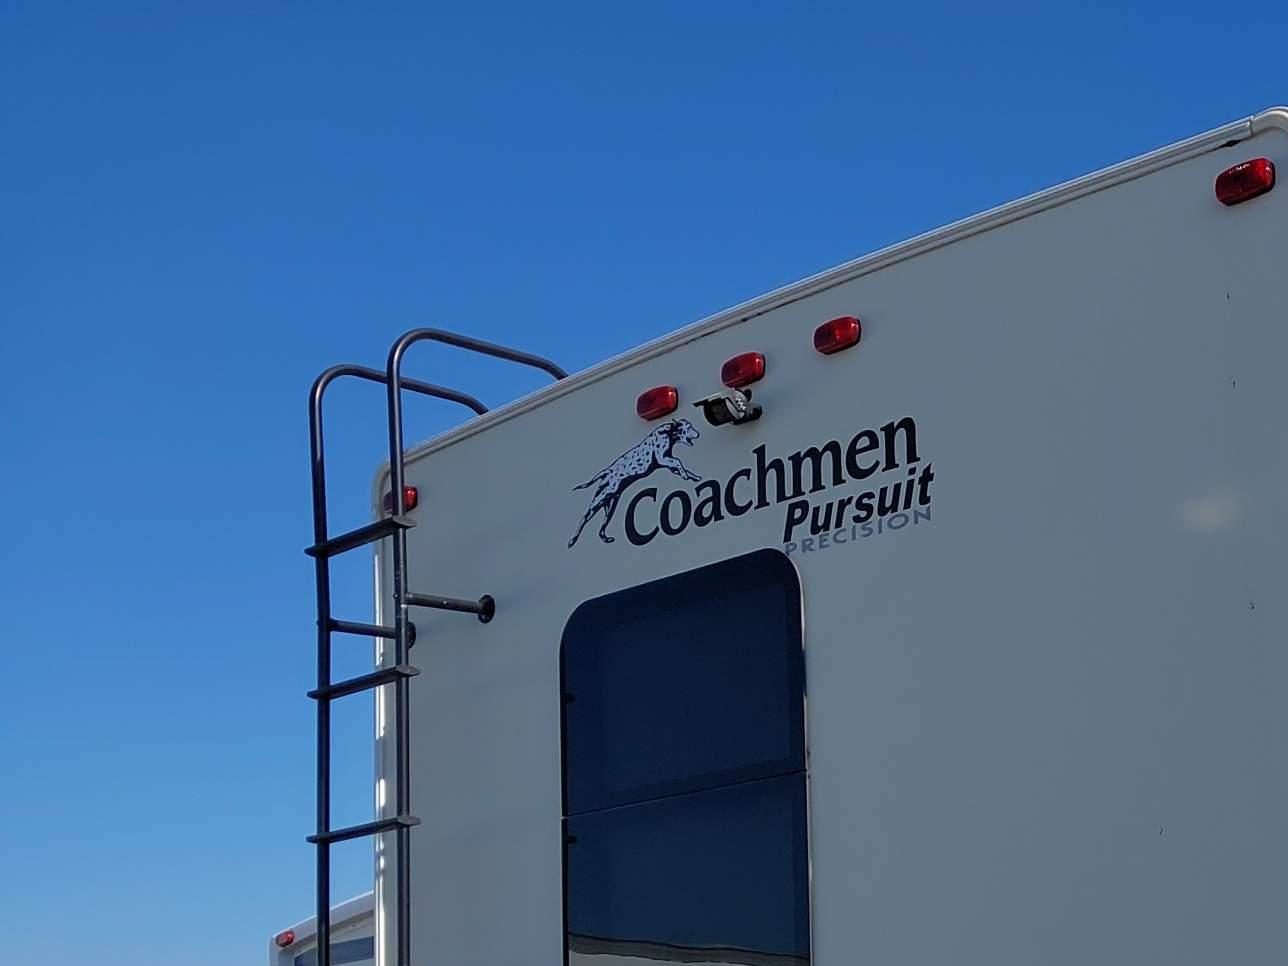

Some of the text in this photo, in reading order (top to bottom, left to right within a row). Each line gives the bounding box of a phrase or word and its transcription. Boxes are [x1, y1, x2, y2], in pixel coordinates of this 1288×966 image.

[624, 416, 922, 547] Coachmen
[782, 463, 936, 544] Pursuit
[785, 507, 933, 558] PRECISION
